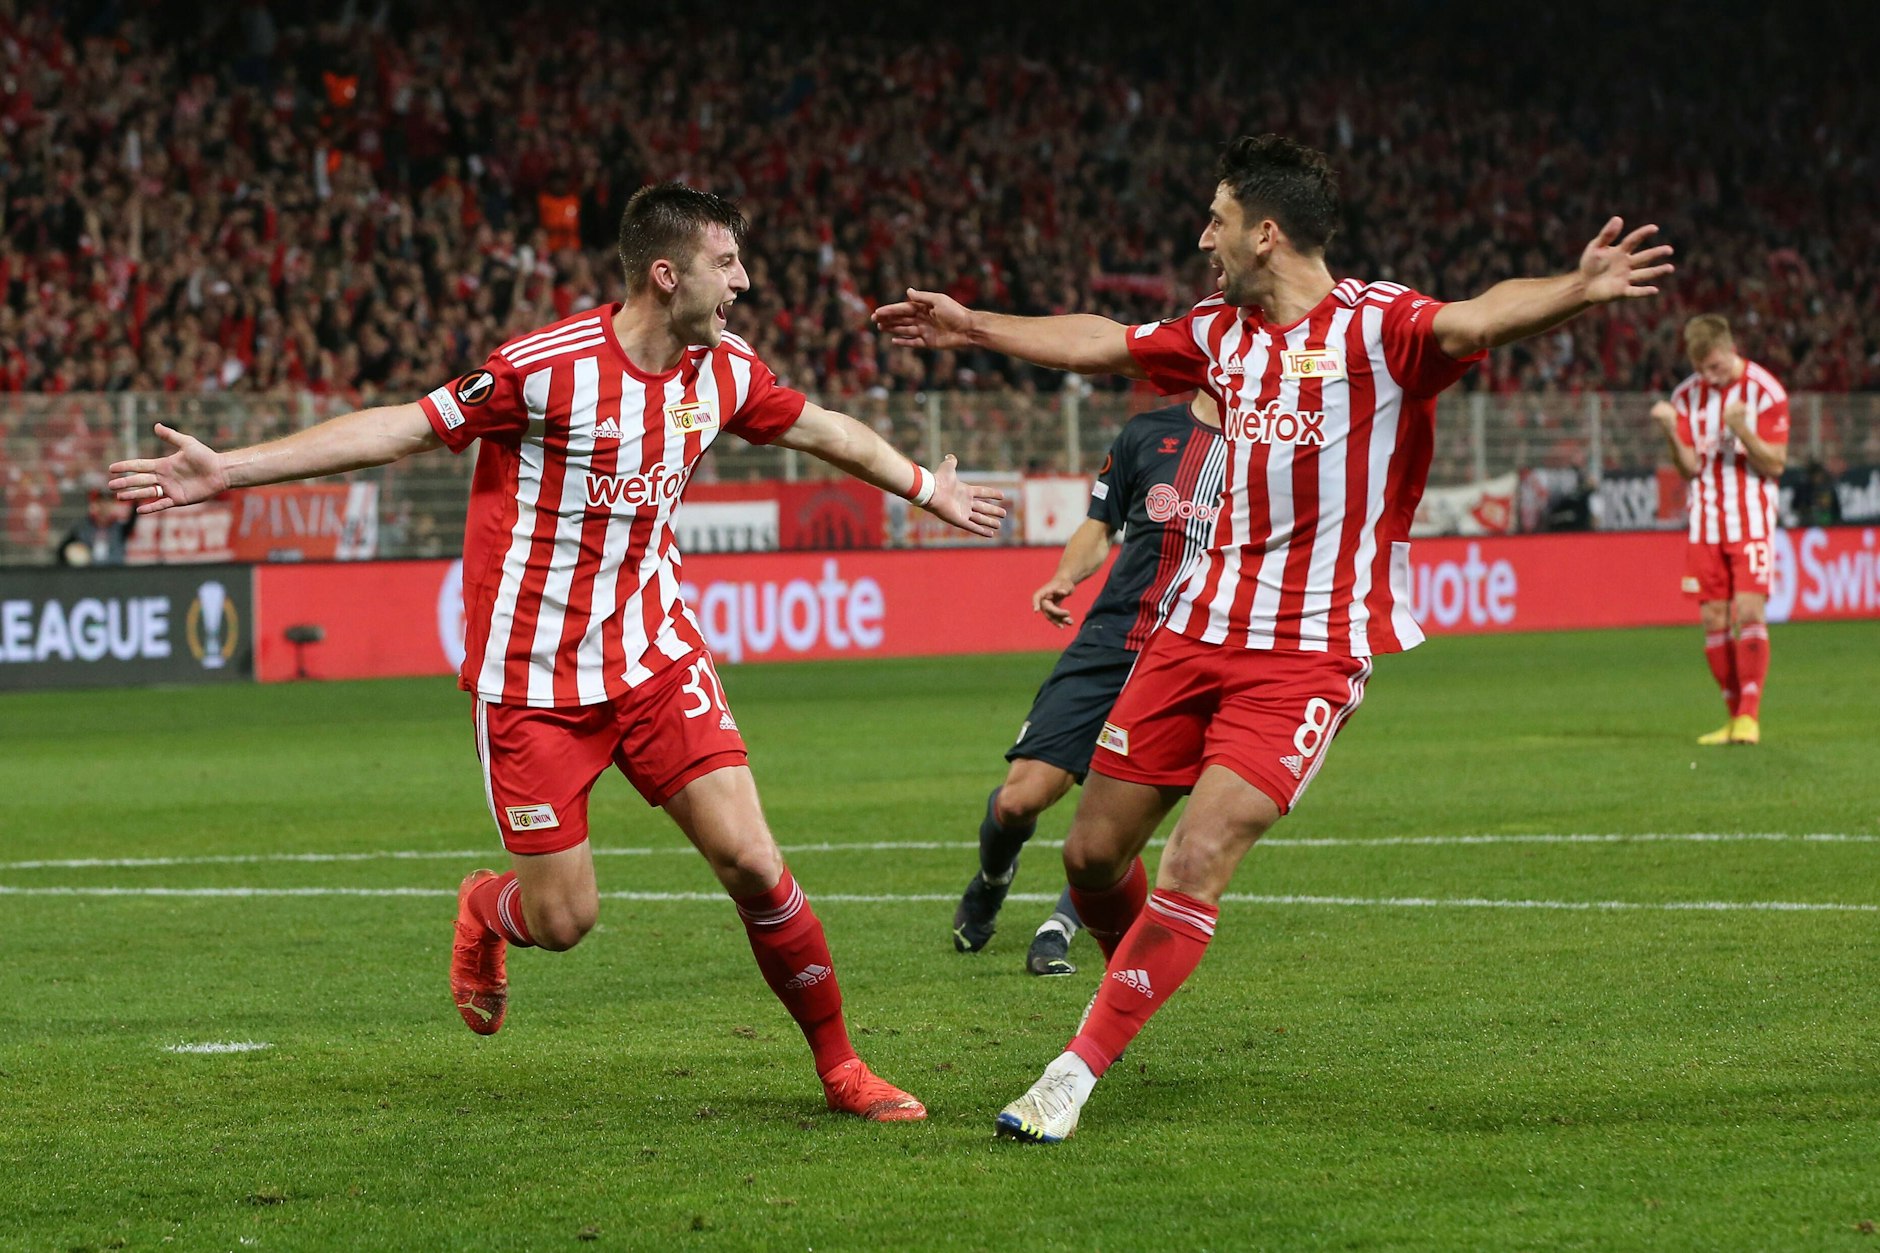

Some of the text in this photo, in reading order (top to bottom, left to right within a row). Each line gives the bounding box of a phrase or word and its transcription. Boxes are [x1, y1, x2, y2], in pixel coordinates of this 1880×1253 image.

[591, 430, 624, 440] adidas
[1226, 402, 1326, 445] wefox
[1801, 526, 1880, 612] Swi
[1294, 697, 1331, 758] 8
[531, 814, 551, 823] UNION
[785, 966, 831, 990] adidas
[1112, 972, 1154, 998] adidas
